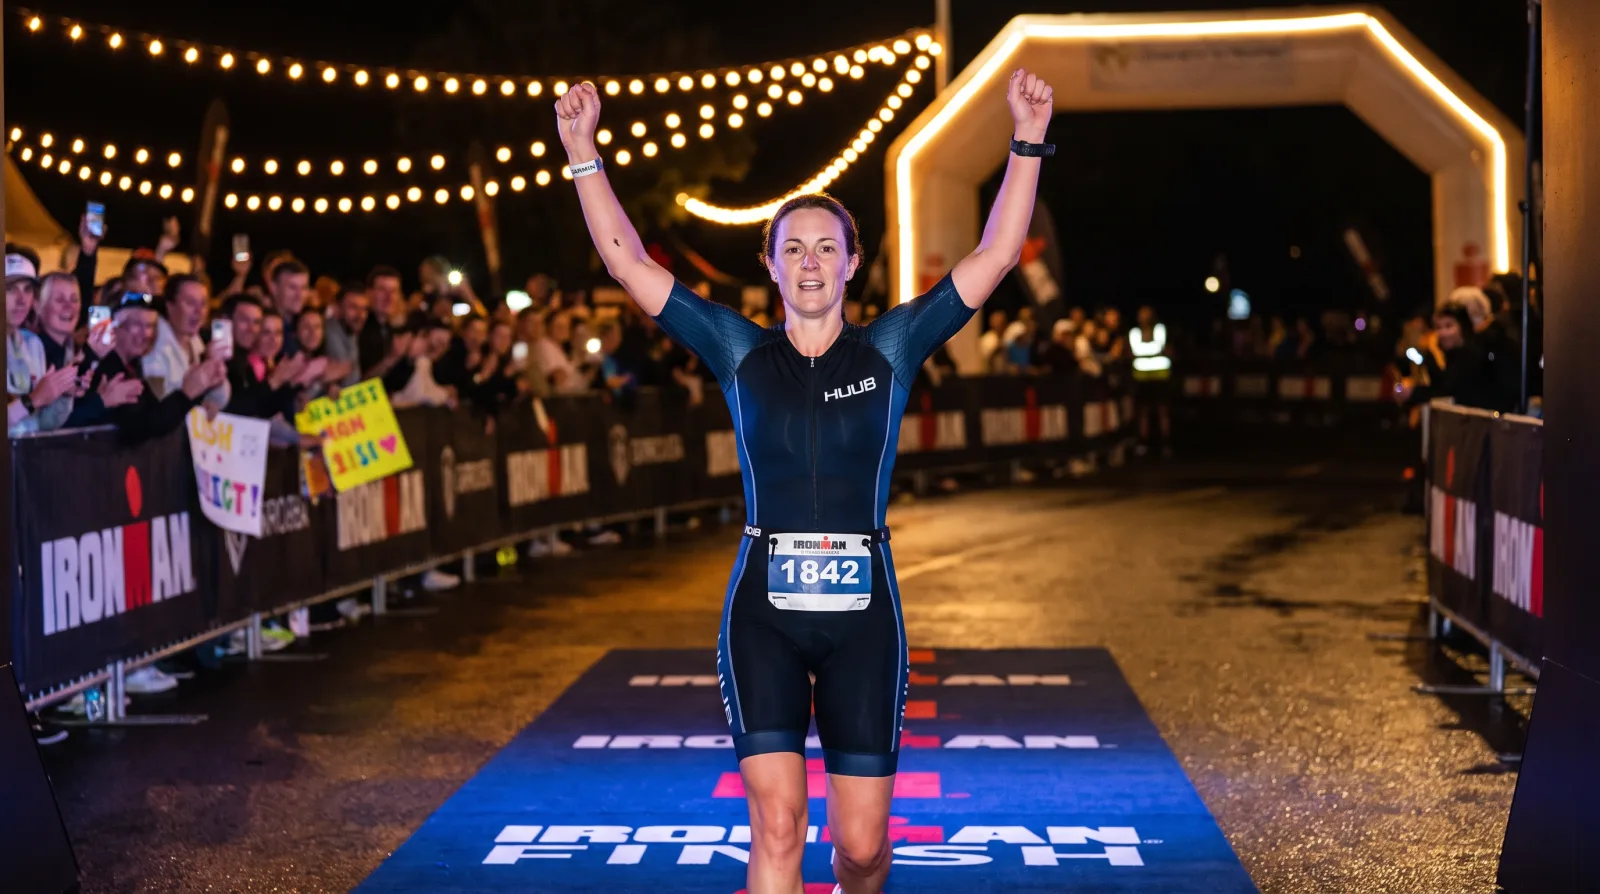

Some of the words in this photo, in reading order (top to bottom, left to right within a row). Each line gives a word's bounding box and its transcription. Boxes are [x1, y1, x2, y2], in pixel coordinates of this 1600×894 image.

[823, 376, 877, 402] HUUB
[793, 536, 847, 550] IRONMAN
[41, 508, 194, 636] IRONMAN
[781, 560, 860, 584] 1842
